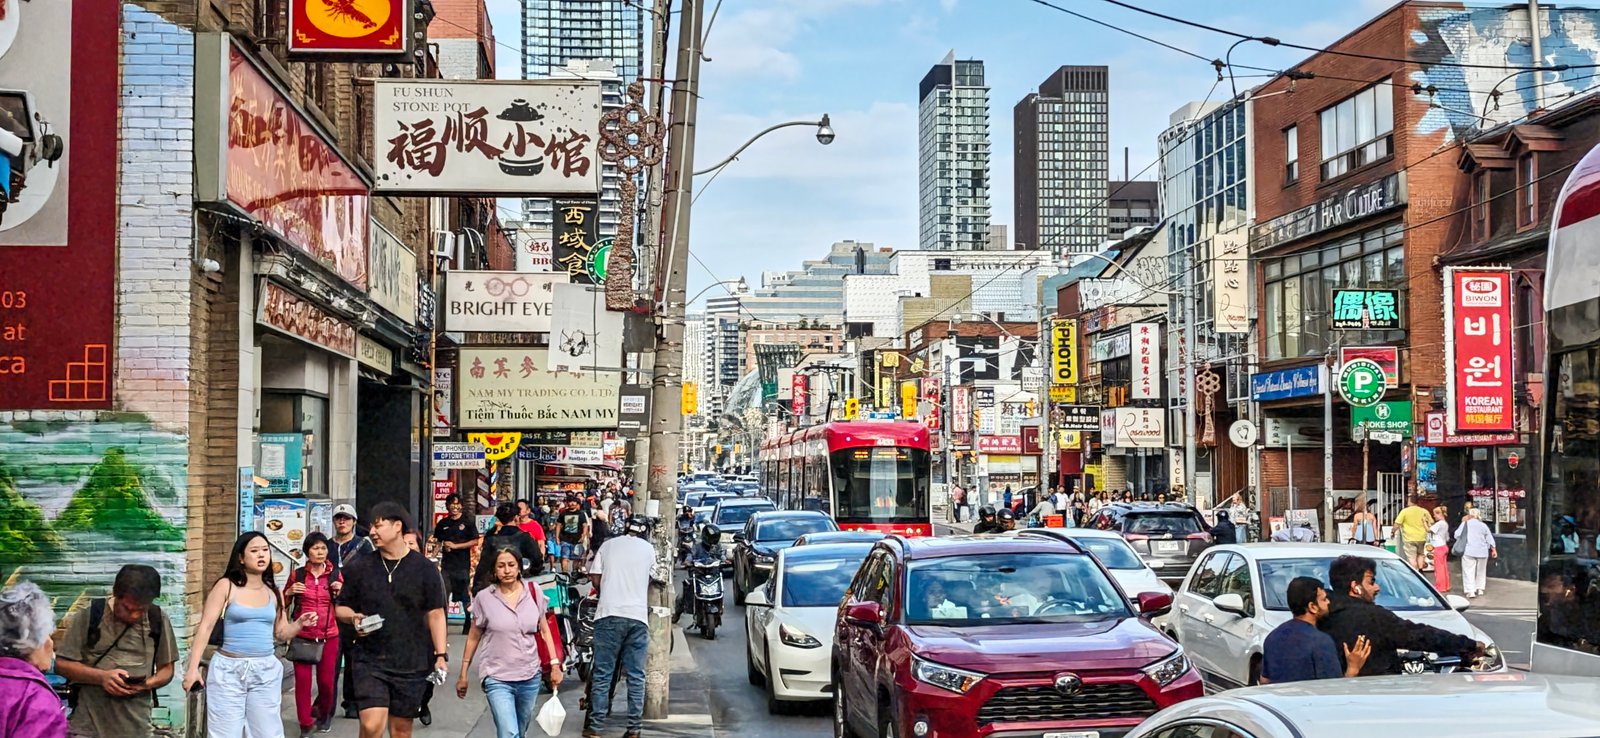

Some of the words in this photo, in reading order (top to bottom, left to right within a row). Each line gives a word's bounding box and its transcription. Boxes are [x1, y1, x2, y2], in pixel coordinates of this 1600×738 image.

[393, 88, 411, 97] FU
[414, 87, 454, 97] SHUN
[393, 102, 438, 112] STONE
[444, 102, 470, 113] POT
[386, 106, 591, 177] 福顺小馆
[529, 241, 553, 252] 好兄
[559, 206, 592, 283] 西域食
[451, 302, 517, 315] BRIGHT
[523, 302, 552, 315] EYE
[1333, 291, 1398, 320] 偶像
[3, 323, 26, 340] at
[1058, 328, 1071, 379] PHOTO
[1463, 313, 1503, 387] 비원
[469, 389, 494, 397] NAM
[498, 389, 514, 397] MY
[517, 389, 568, 397] TRADING
[570, 389, 589, 397] CO.
[593, 389, 615, 397] LTD.
[1343, 386, 1383, 404] PARKING
[1465, 396, 1503, 406] KOREAN
[498, 405, 534, 420] Thuốc
[537, 405, 558, 420] Bắc
[561, 409, 593, 420] NAM
[595, 409, 616, 420] MY
[1118, 412, 1161, 446] Rosewood
[1358, 421, 1386, 429] SOKE
[1373, 432, 1390, 440] LARCH
[474, 437, 515, 455] NODLES
[519, 451, 539, 459] RBC
